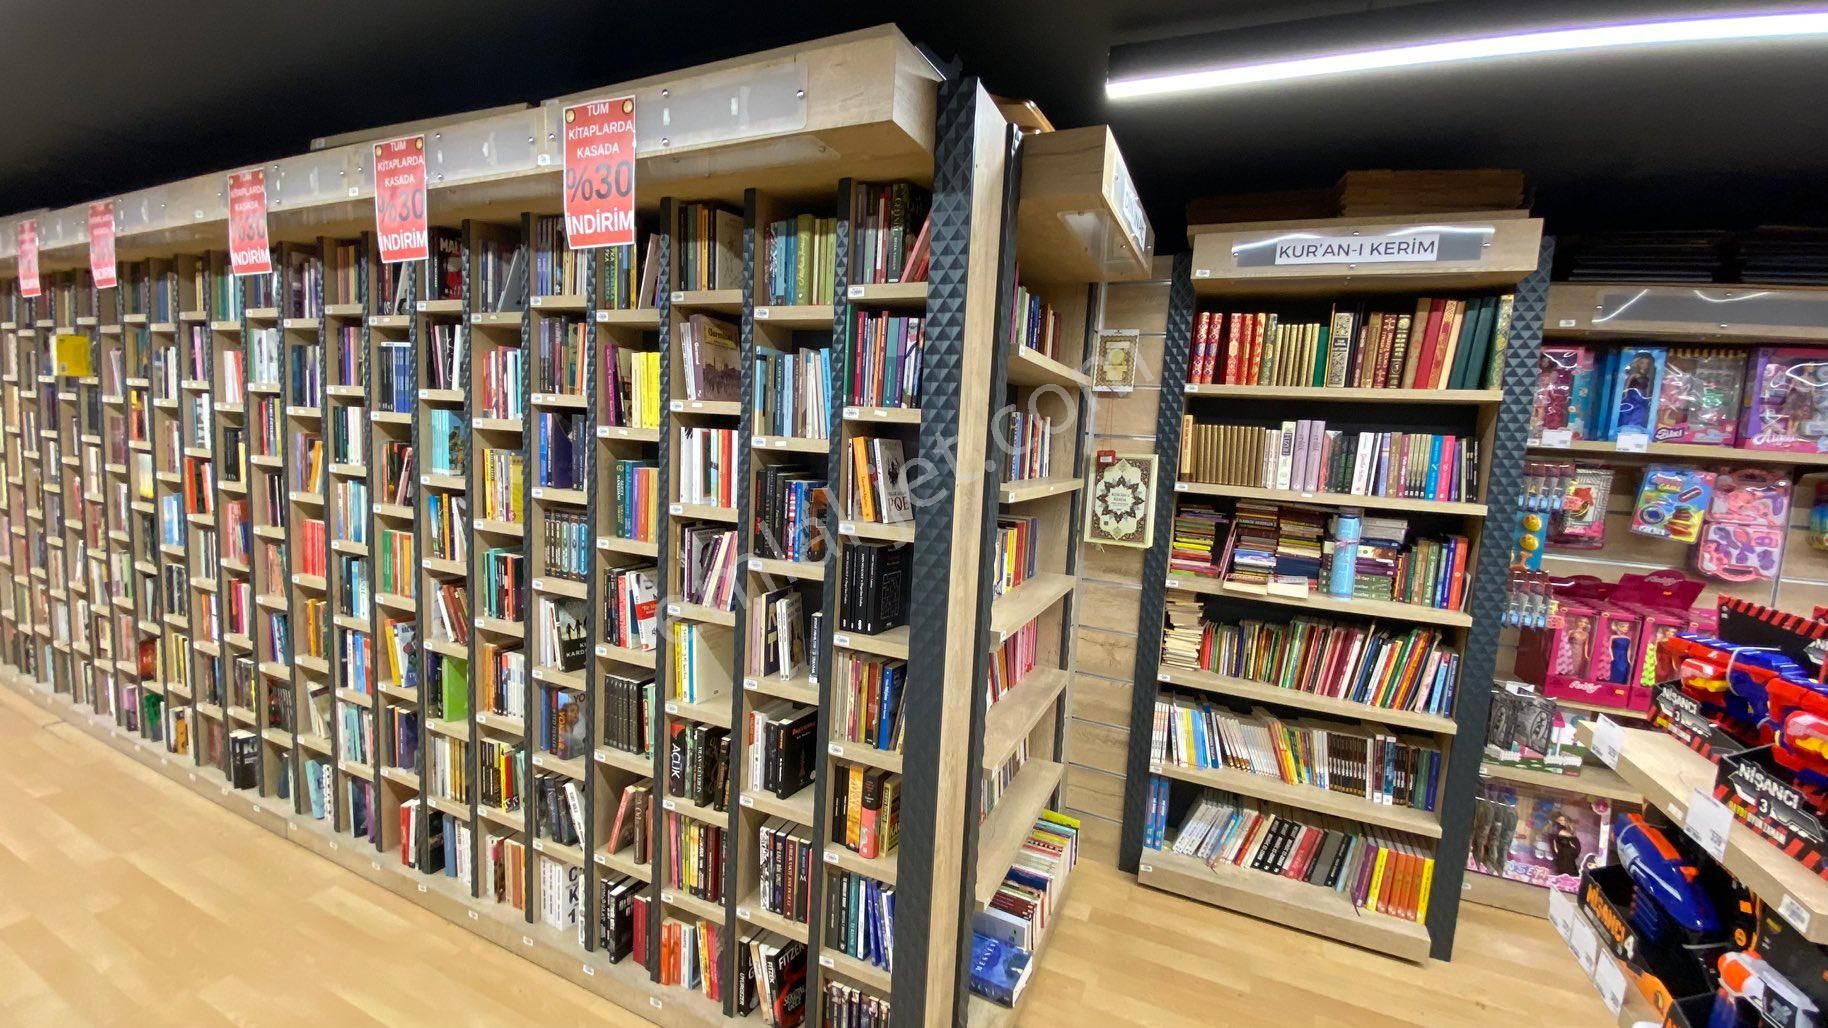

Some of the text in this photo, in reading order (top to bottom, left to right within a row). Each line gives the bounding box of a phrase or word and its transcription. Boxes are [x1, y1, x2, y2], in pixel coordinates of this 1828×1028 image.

[568, 120, 634, 140] KİTAPLARDA
[577, 142, 620, 159] KASADA
[384, 173, 416, 188] KASADA
[566, 160, 633, 203] %30
[376, 188, 425, 226] %30
[567, 207, 634, 236] İNDİRİM
[379, 227, 428, 252] İNDİRİM
[1277, 236, 1436, 260] KUR'AN-I KERİM
[888, 496, 910, 512] POE
[1674, 710, 1682, 723] 3
[1738, 763, 1800, 810] NİŞANCI
[1758, 800, 1769, 814] 3
[1623, 935, 1635, 961] 4
